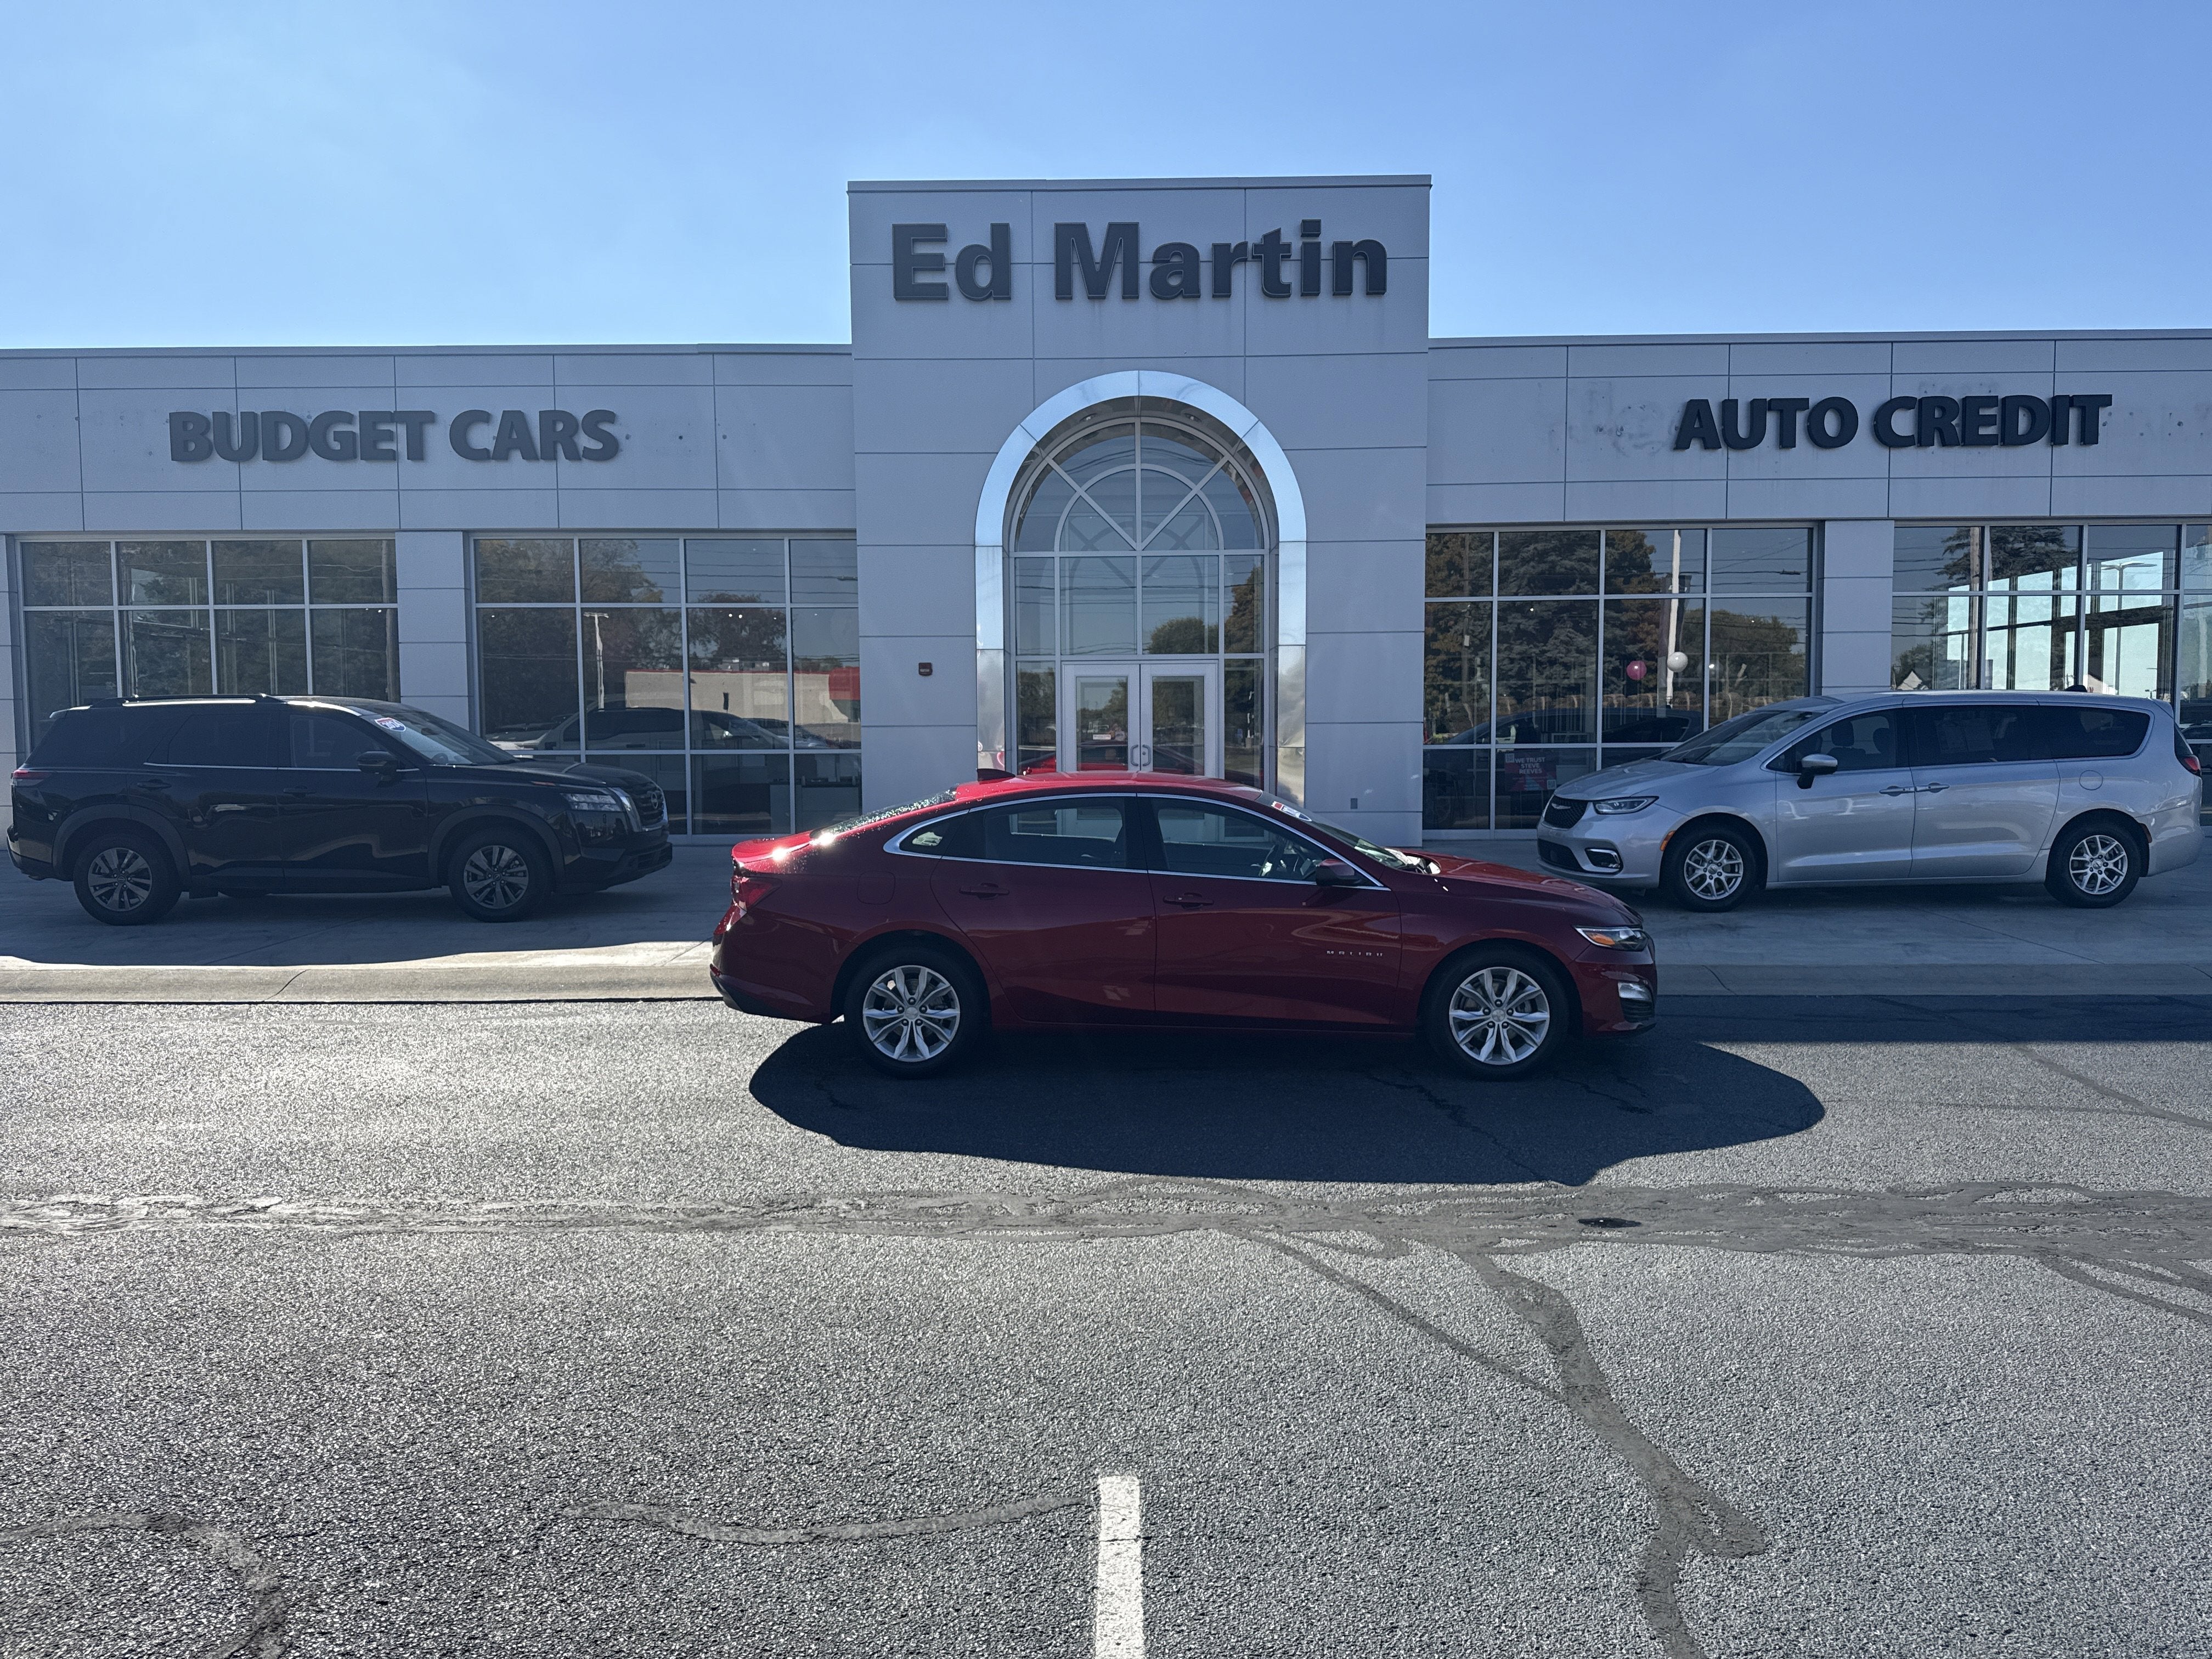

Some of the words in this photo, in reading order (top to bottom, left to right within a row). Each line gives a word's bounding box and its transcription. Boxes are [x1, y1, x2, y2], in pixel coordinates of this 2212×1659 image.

[892, 222, 1012, 302] Ed
[1054, 219, 1387, 301] Martin
[169, 410, 436, 462] BUDGET
[449, 410, 620, 461] CARS
[1673, 397, 1859, 450] AUTO
[1874, 393, 2113, 448] CREDIT
